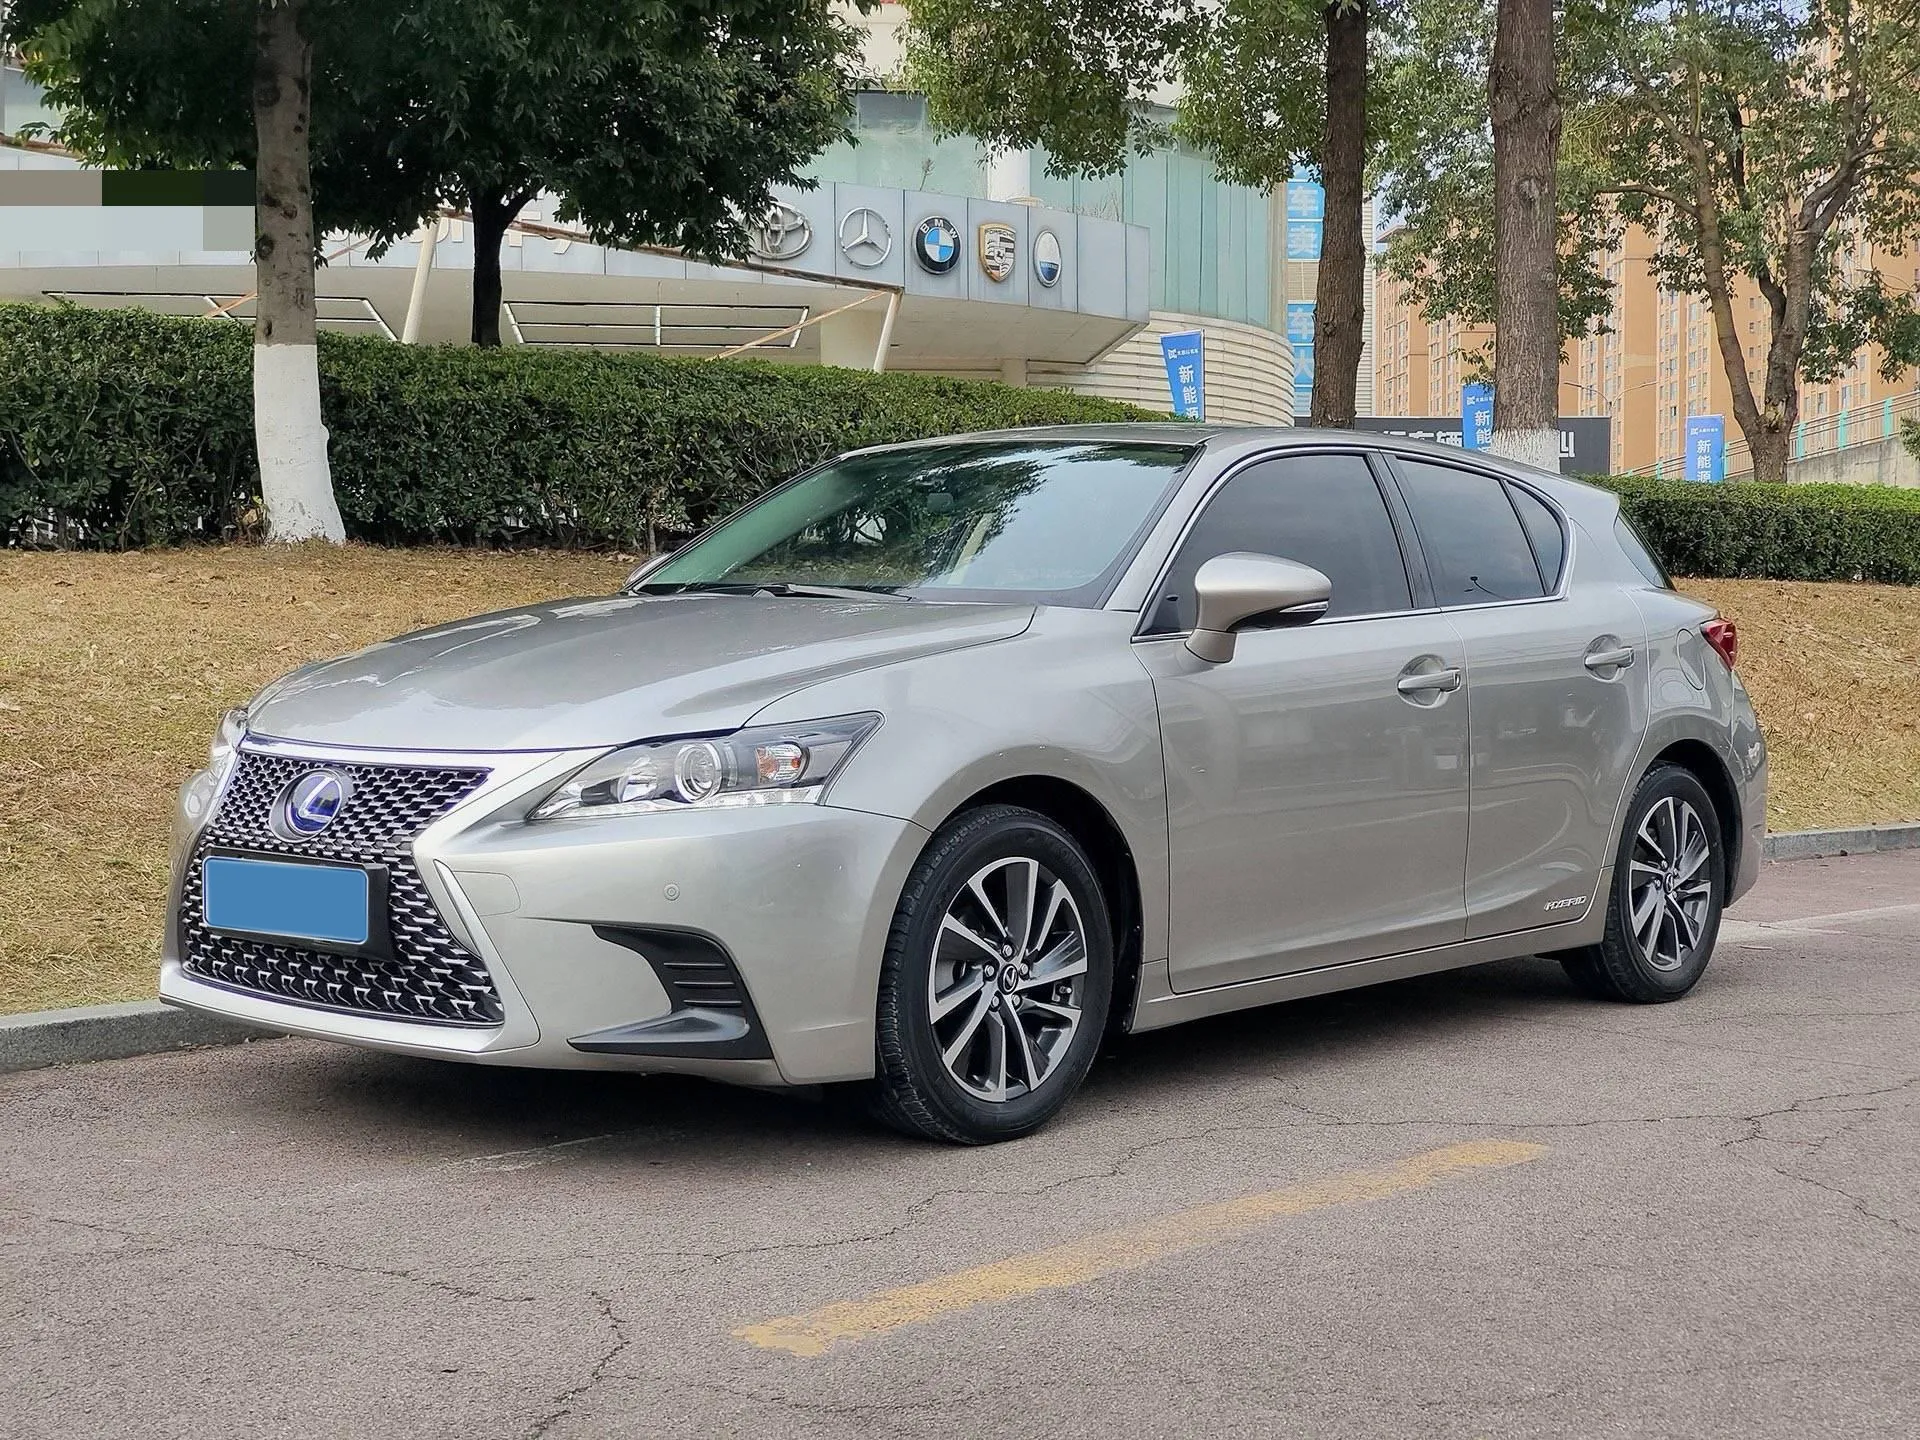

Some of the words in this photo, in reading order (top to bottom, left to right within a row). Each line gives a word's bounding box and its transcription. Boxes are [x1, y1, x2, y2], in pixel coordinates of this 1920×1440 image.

[919, 218, 959, 239] BMW
[1696, 439, 1712, 483] 新能源
[1543, 895, 1587, 911] HYBRID
